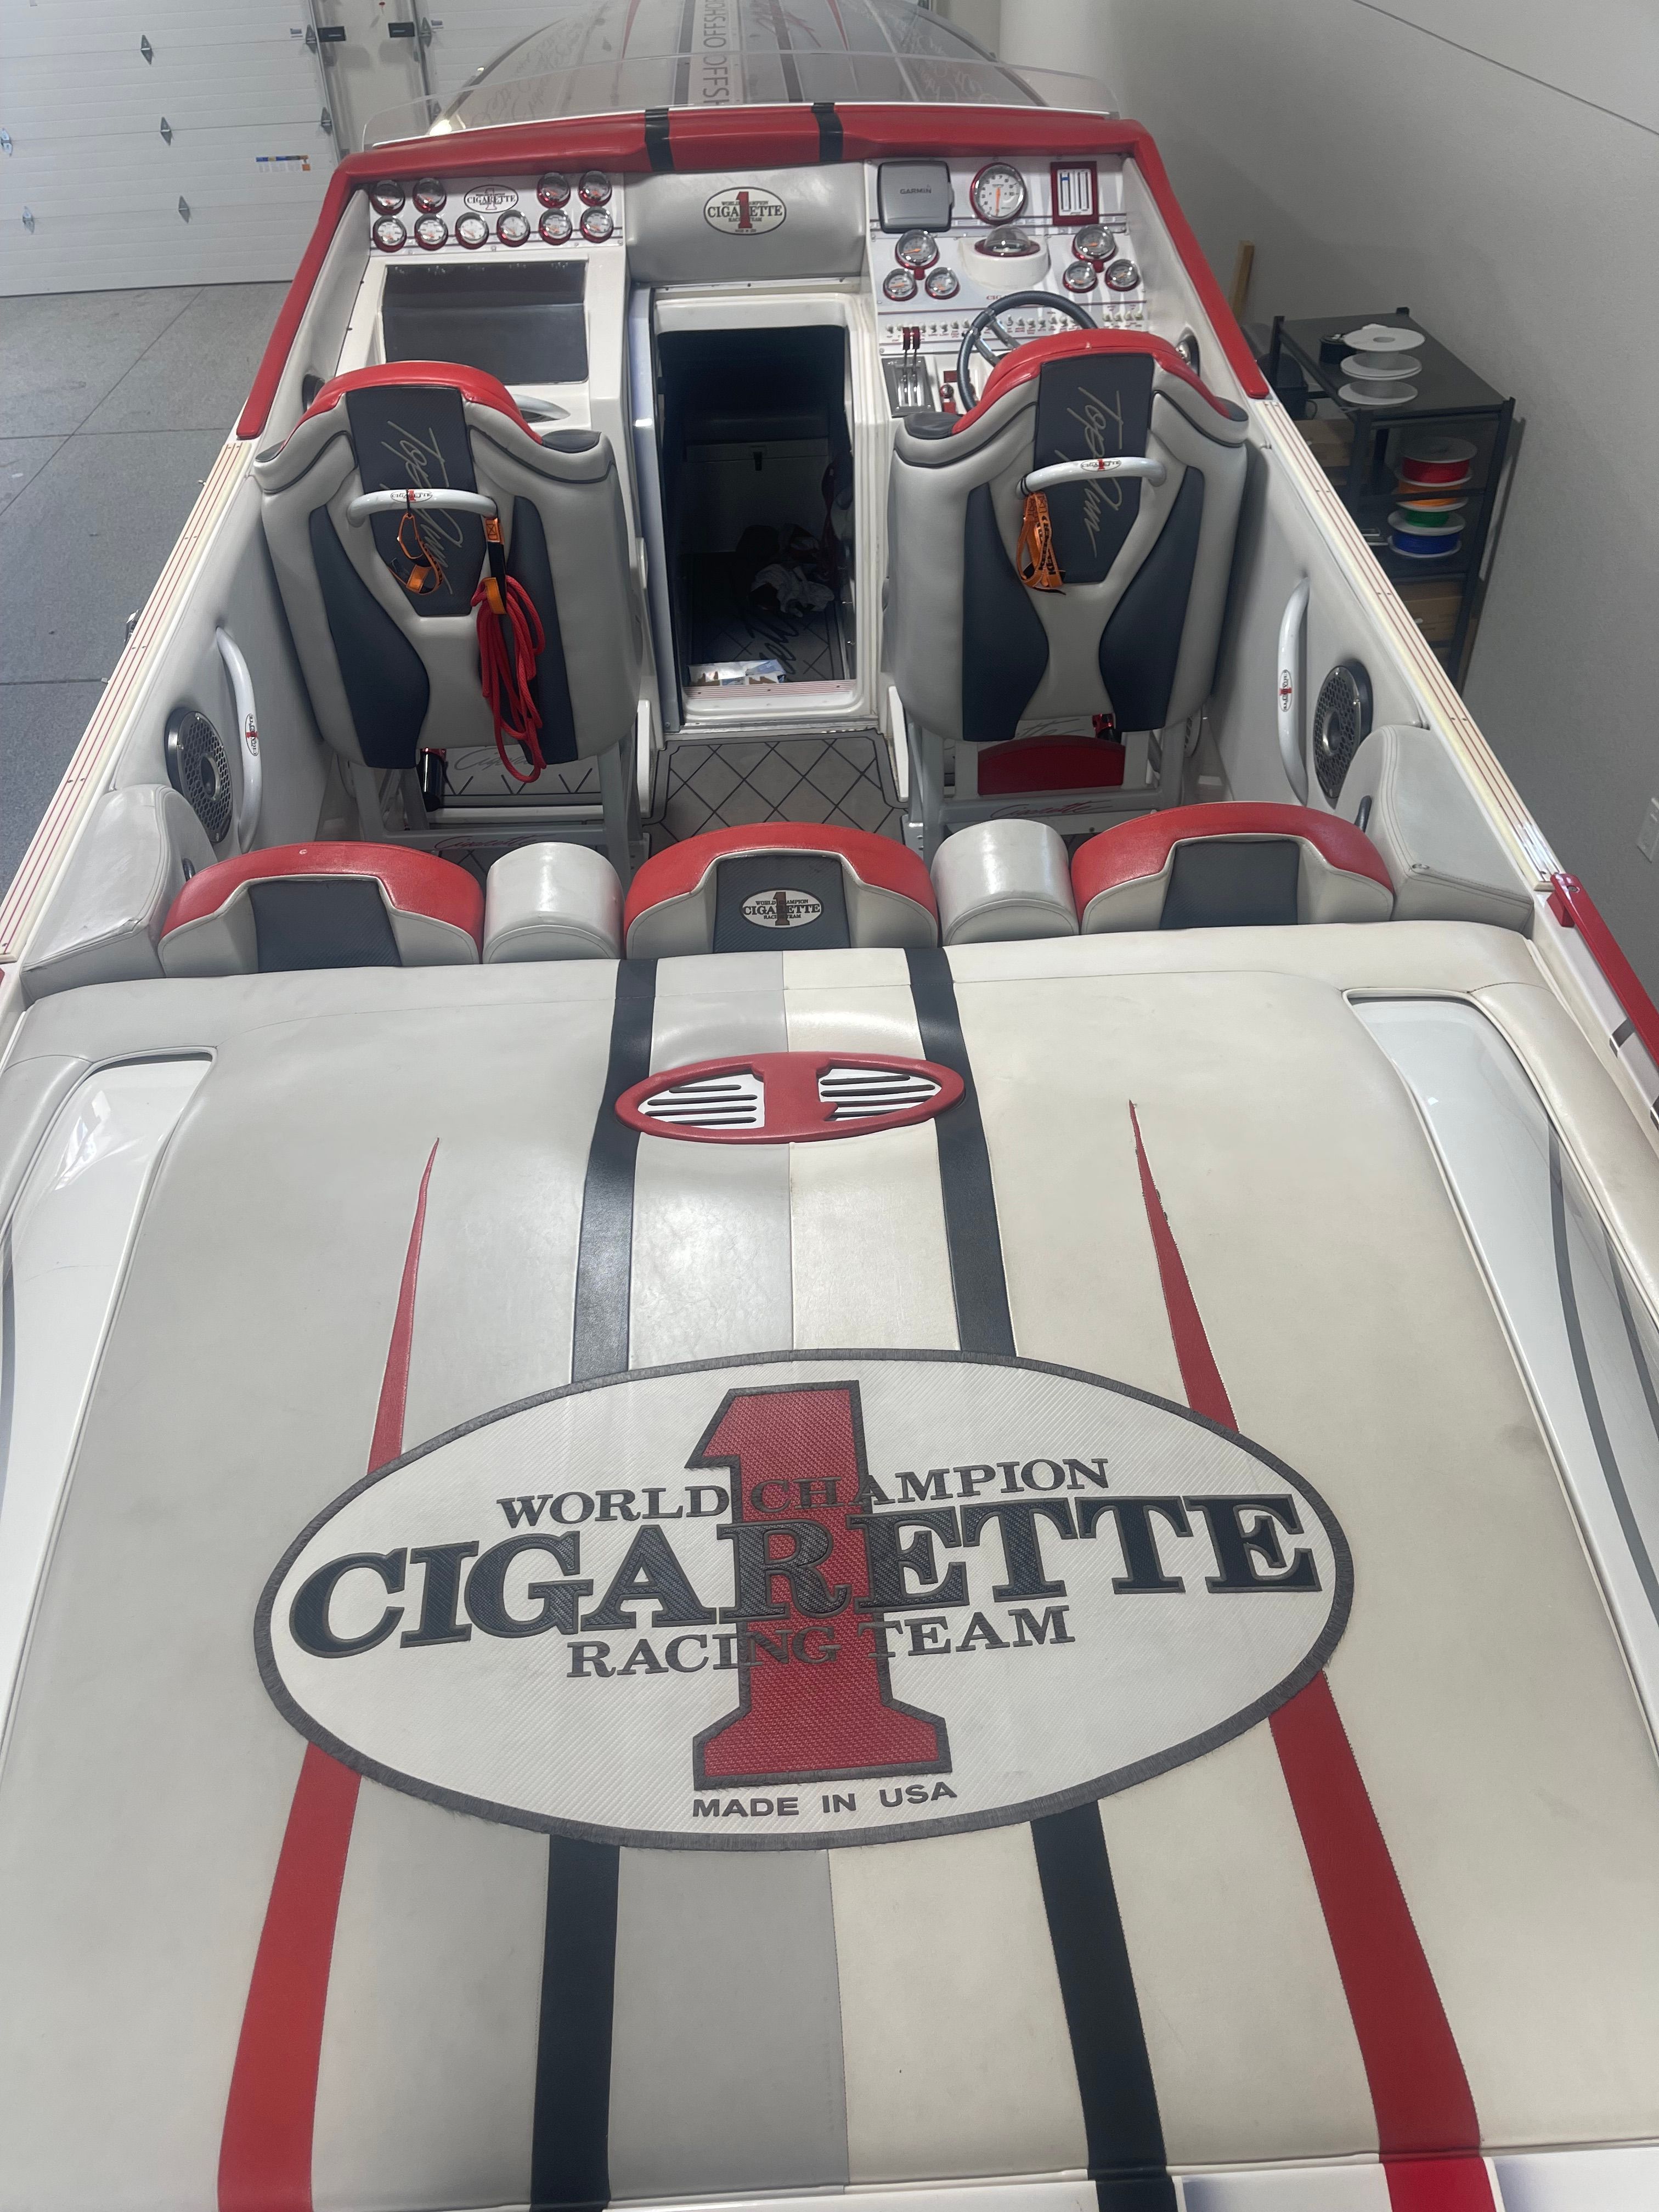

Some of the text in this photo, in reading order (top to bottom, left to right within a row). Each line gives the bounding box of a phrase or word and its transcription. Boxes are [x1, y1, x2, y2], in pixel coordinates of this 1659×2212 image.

[467, 194, 516, 204] CIGARETTE
[708, 205, 783, 218] CIGAETTE
[496, 1458, 1109, 1528] WORLD CHAMPION
[289, 1494, 1323, 1659] CIGARETTE
[685, 1380, 952, 1791] 1
[566, 1606, 1076, 1678] RACING TEAM
[692, 1781, 958, 1818] MADE IN USA
